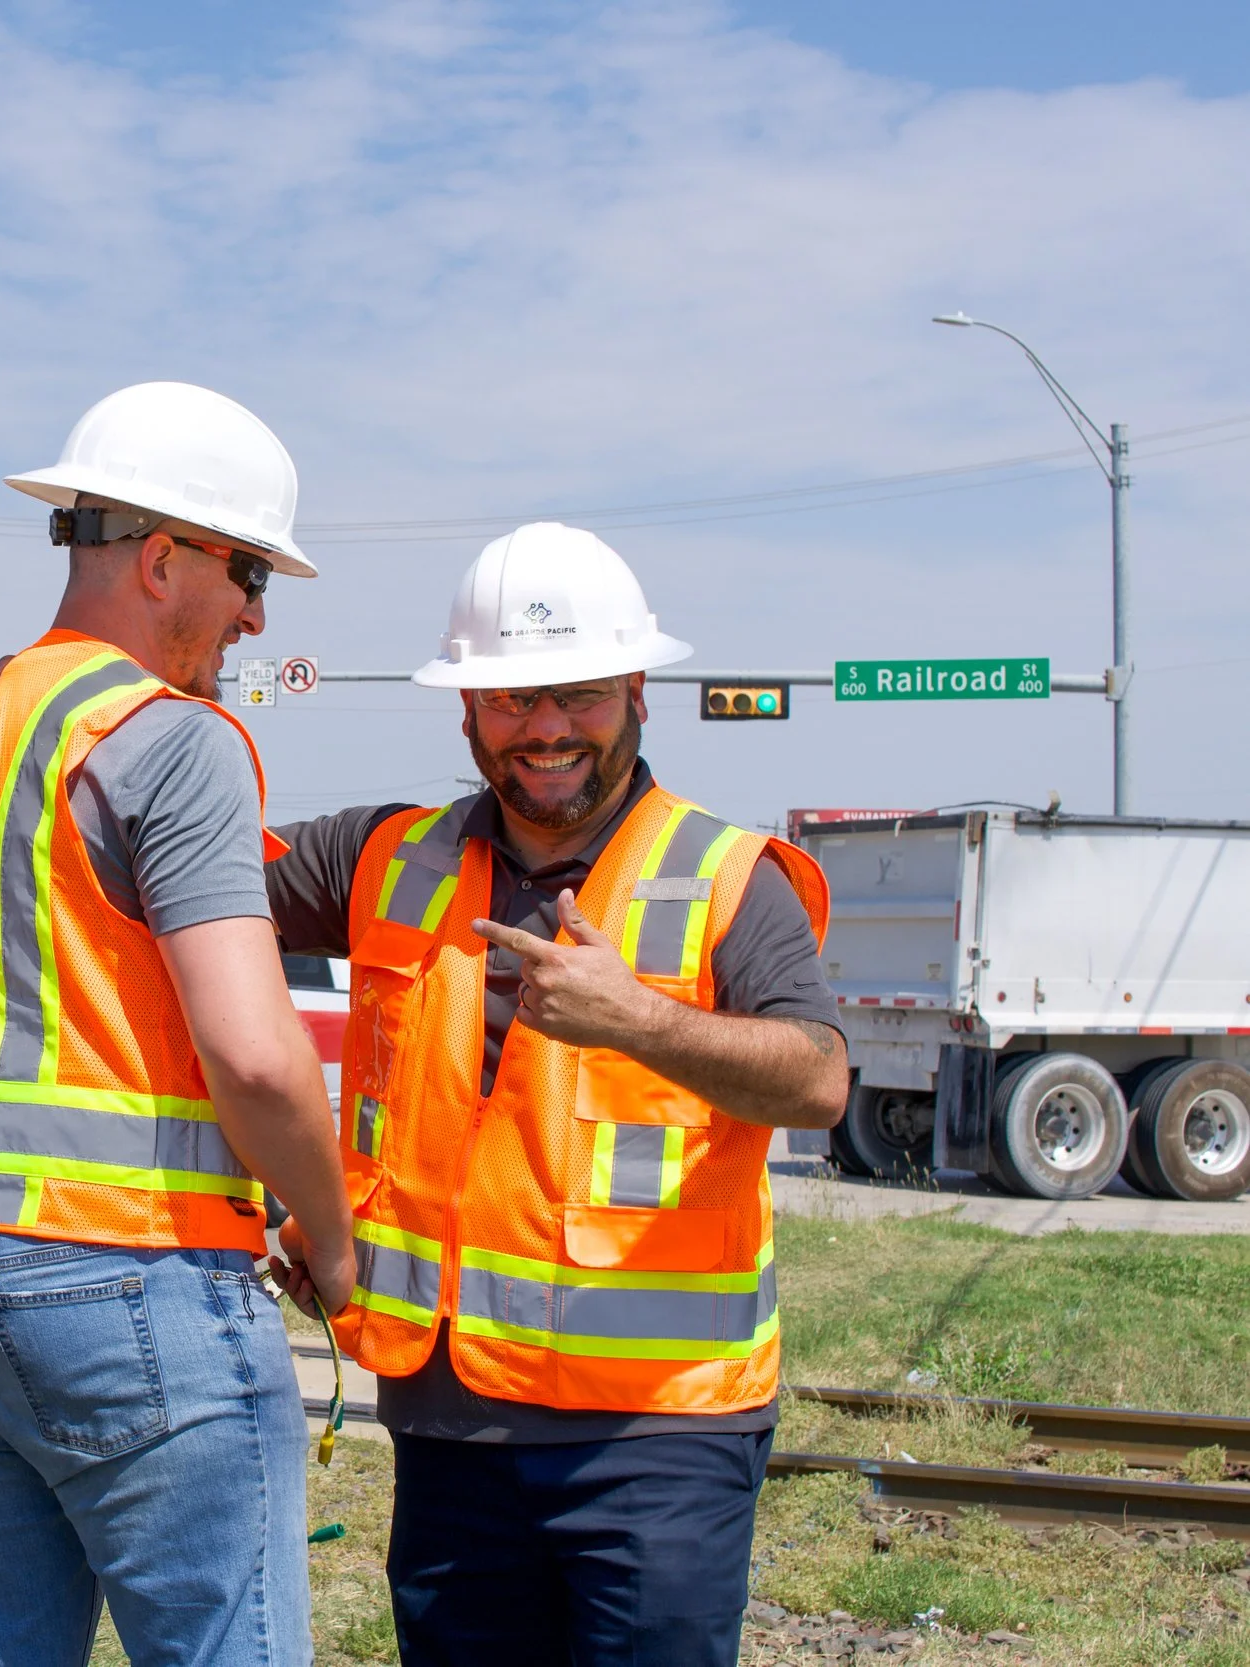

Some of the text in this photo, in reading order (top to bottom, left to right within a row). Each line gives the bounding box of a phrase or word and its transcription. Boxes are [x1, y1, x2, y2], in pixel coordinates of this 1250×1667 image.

[244, 669, 271, 679] YIELD
[850, 663, 1037, 692] S Railroad St
[841, 683, 867, 696] 600
[1017, 680, 1043, 693] 400
